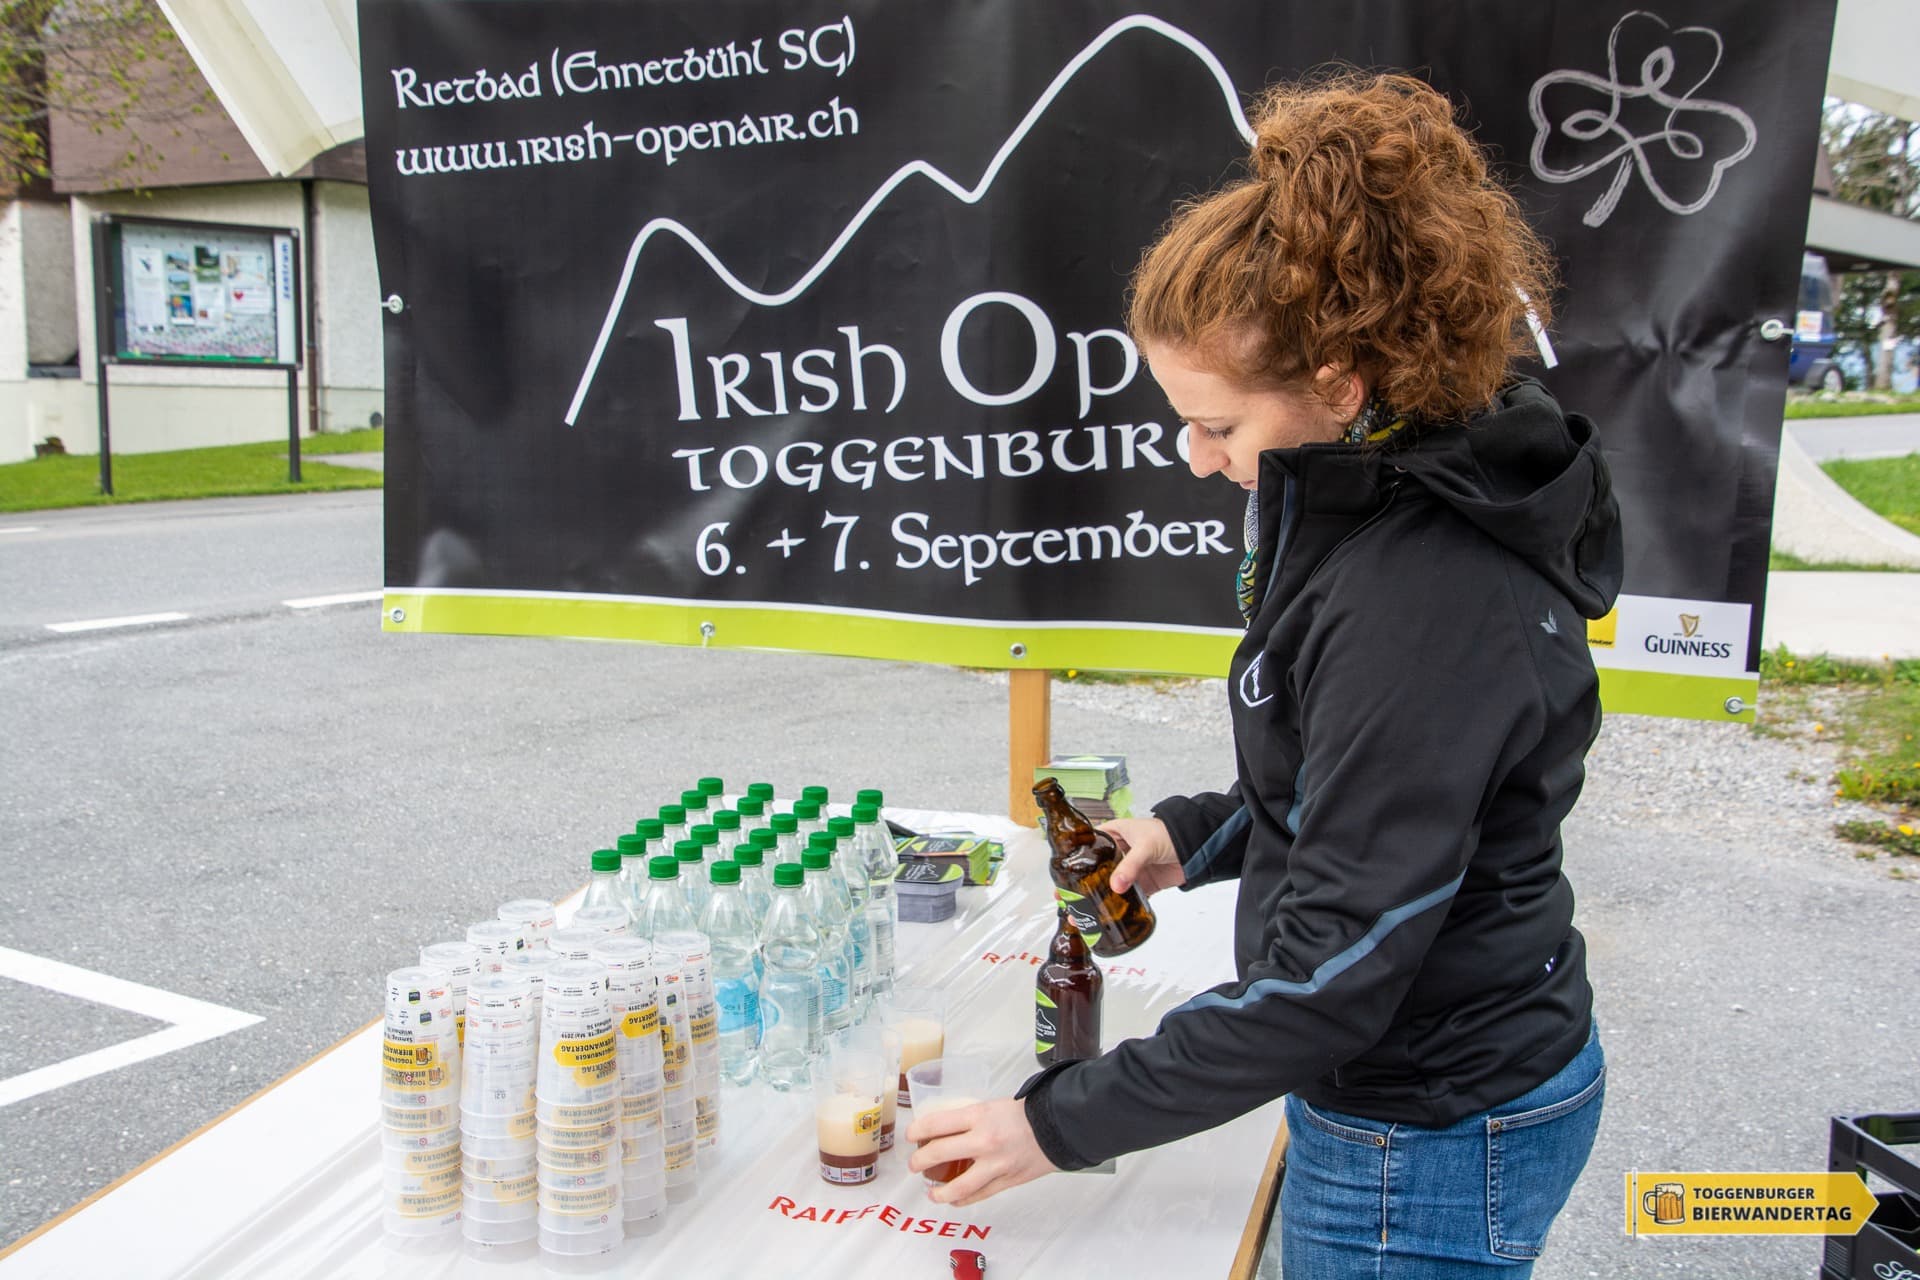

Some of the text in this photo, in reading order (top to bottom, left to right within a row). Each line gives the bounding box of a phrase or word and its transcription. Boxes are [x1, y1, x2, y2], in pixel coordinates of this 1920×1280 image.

[391, 16, 857, 109] Rietbad (Ennetbühl SG)
[396, 97, 859, 176] www.irish-openair.ch
[695, 510, 1234, 587] 6. + 7. September
[1644, 634, 1731, 658] GUINNESS
[768, 1195, 992, 1241] RAIFFEISEN
